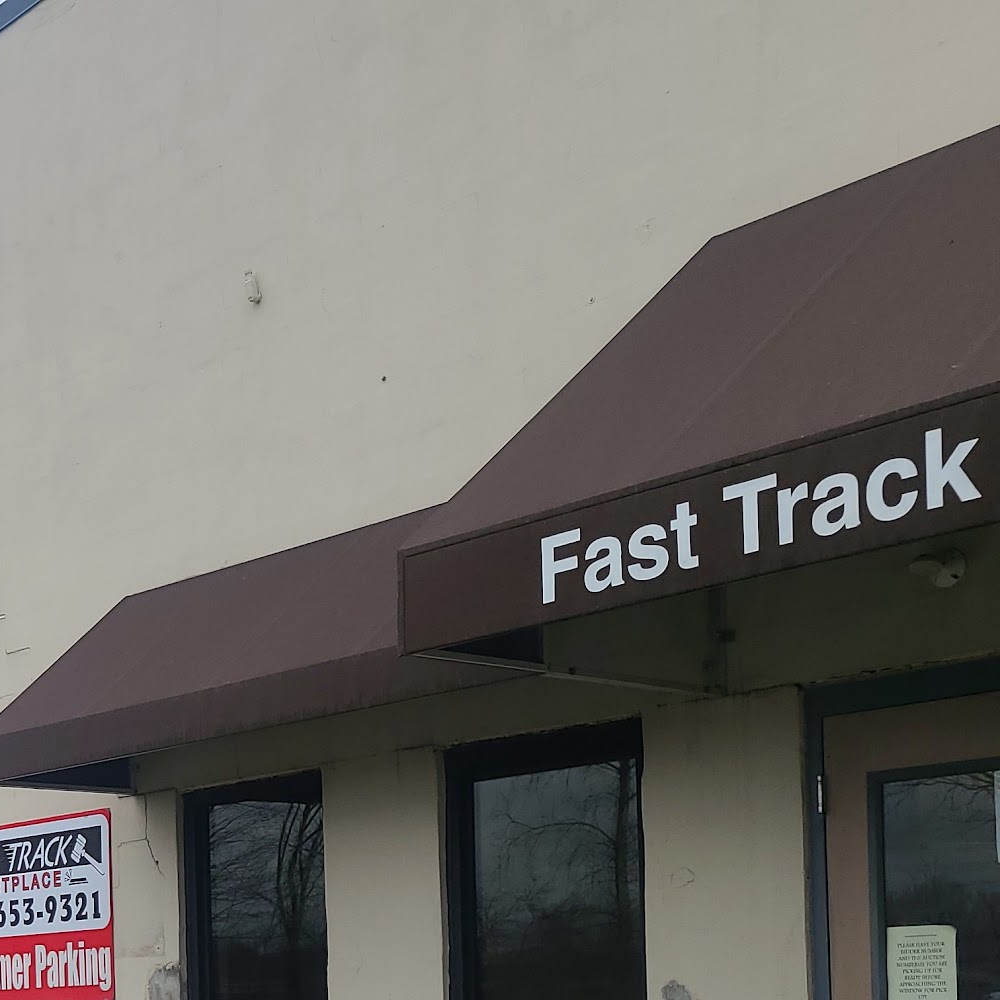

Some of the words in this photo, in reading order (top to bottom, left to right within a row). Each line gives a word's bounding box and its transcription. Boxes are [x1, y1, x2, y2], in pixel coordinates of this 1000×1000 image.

[541, 501, 699, 604] Fast
[723, 428, 982, 555] Track
[3, 834, 73, 872] TRACK
[34, 941, 111, 991] Parking
